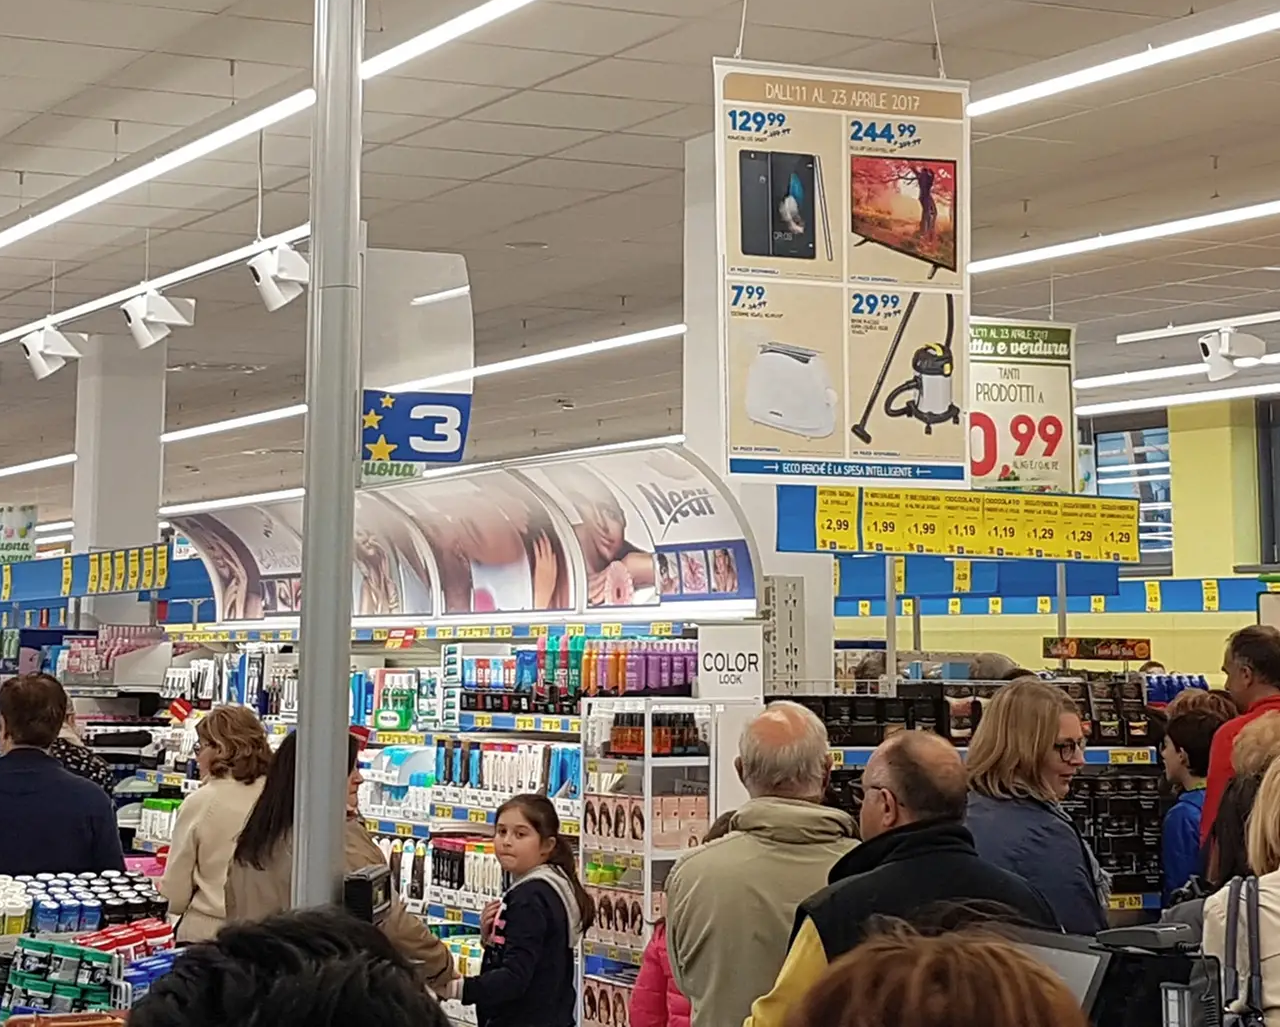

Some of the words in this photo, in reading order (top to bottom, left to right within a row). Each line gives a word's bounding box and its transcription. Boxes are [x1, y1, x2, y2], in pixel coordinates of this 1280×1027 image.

[765, 82, 807, 101] DALL'11
[812, 87, 826, 104] AL
[831, 89, 847, 105] 23
[850, 91, 887, 109] APRILE
[891, 95, 920, 111] 2017
[969, 339, 994, 354] tta
[997, 342, 1007, 354] e
[1010, 339, 1069, 355] verdura
[998, 367, 1019, 380] TANTI
[976, 382, 1035, 403] PRODOTTI
[1038, 391, 1044, 403] A
[409, 404, 461, 453] 3
[363, 462, 417, 476] uona
[782, 463, 800, 473] ECCO
[833, 465, 843, 475] LA
[844, 465, 864, 476] SPESA
[865, 466, 912, 477] INTELLIGENTE
[826, 519, 849, 532] 2,99
[873, 521, 895, 534] 1,99
[913, 523, 936, 535] 1,99
[954, 525, 976, 537] 1,19
[993, 526, 1015, 539] 1,19
[1032, 528, 1054, 540] 1,29
[1071, 530, 1093, 543] 1,29
[1109, 532, 1130, 544] 1,29
[703, 653, 759, 673] COLOR
[719, 674, 743, 685] LOOK
